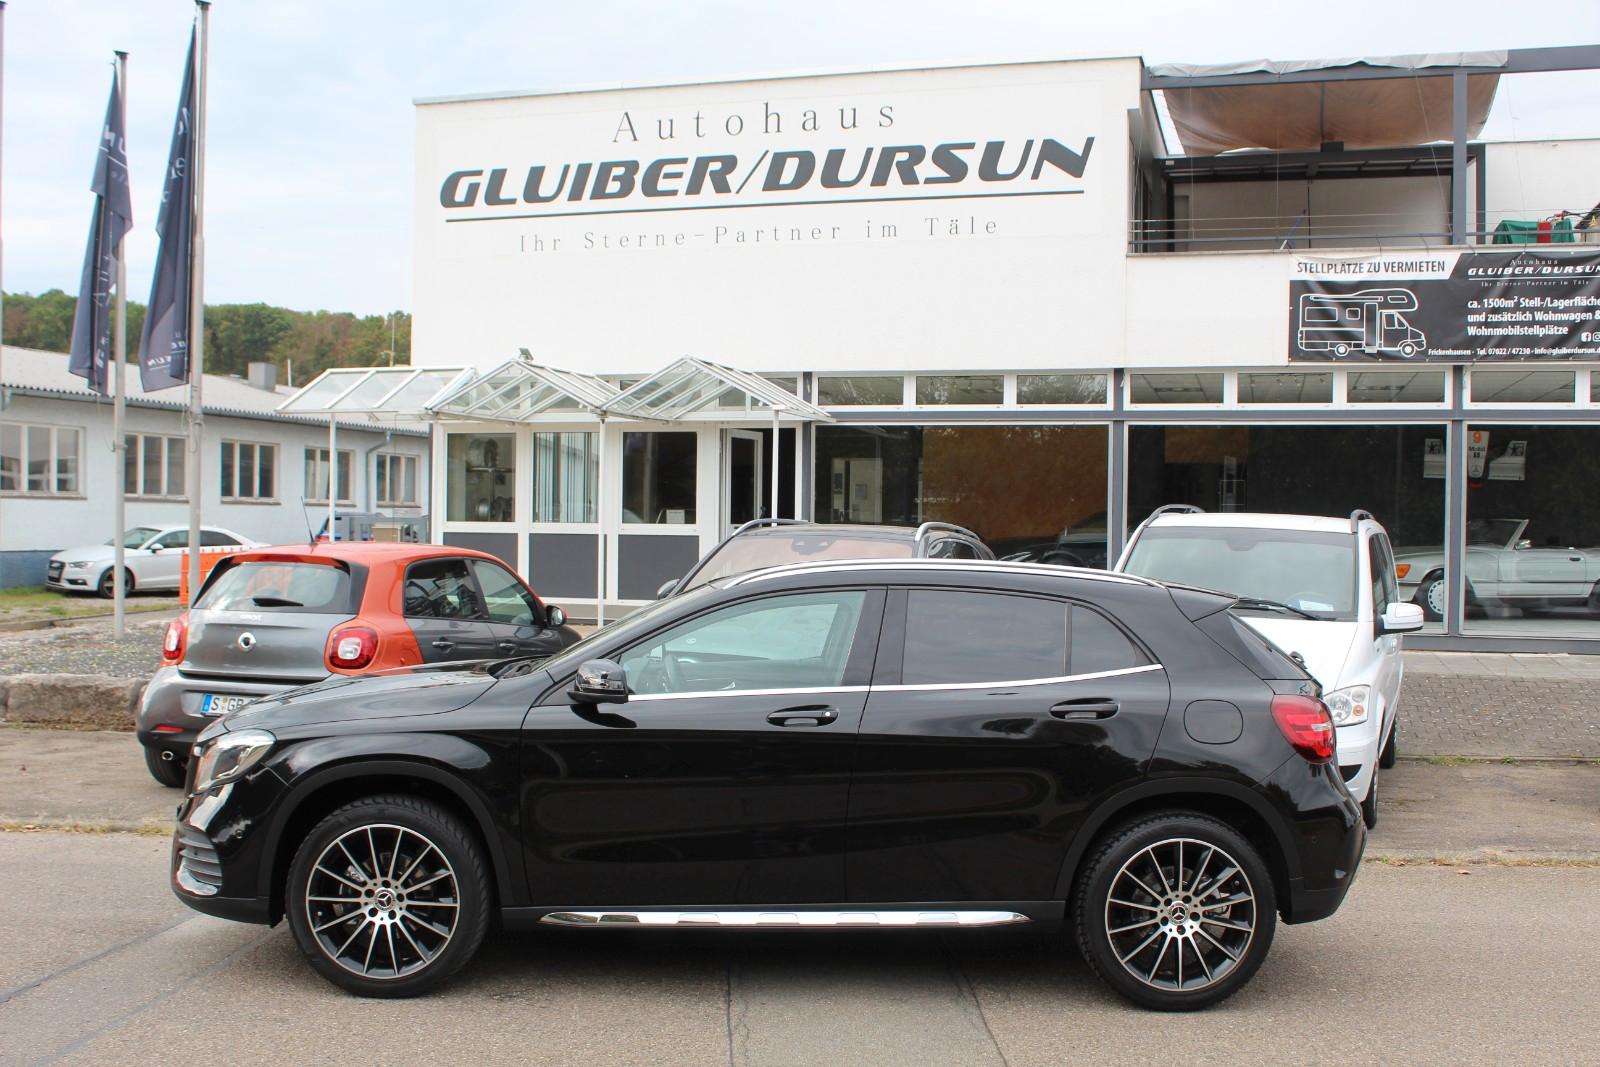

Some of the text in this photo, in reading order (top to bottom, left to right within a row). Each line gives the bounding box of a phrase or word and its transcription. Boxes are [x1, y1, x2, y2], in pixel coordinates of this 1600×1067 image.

[612, 101, 896, 143] Autohaus
[439, 136, 1096, 209] GLUIBER/DURSUN
[519, 215, 998, 253] Ihr Sterne-Partner im Täle
[1297, 260, 1445, 274] STELLPLÄTZE ZU VERMIETEN
[1467, 300, 1481, 308] ca.
[1482, 295, 1518, 308] 1500m²
[1467, 311, 1486, 322] und
[1487, 310, 1533, 322] zusätzlich
[1534, 311, 1592, 322] Wohnwagen
[1467, 325, 1569, 337] Wohnmobilstellplätze
